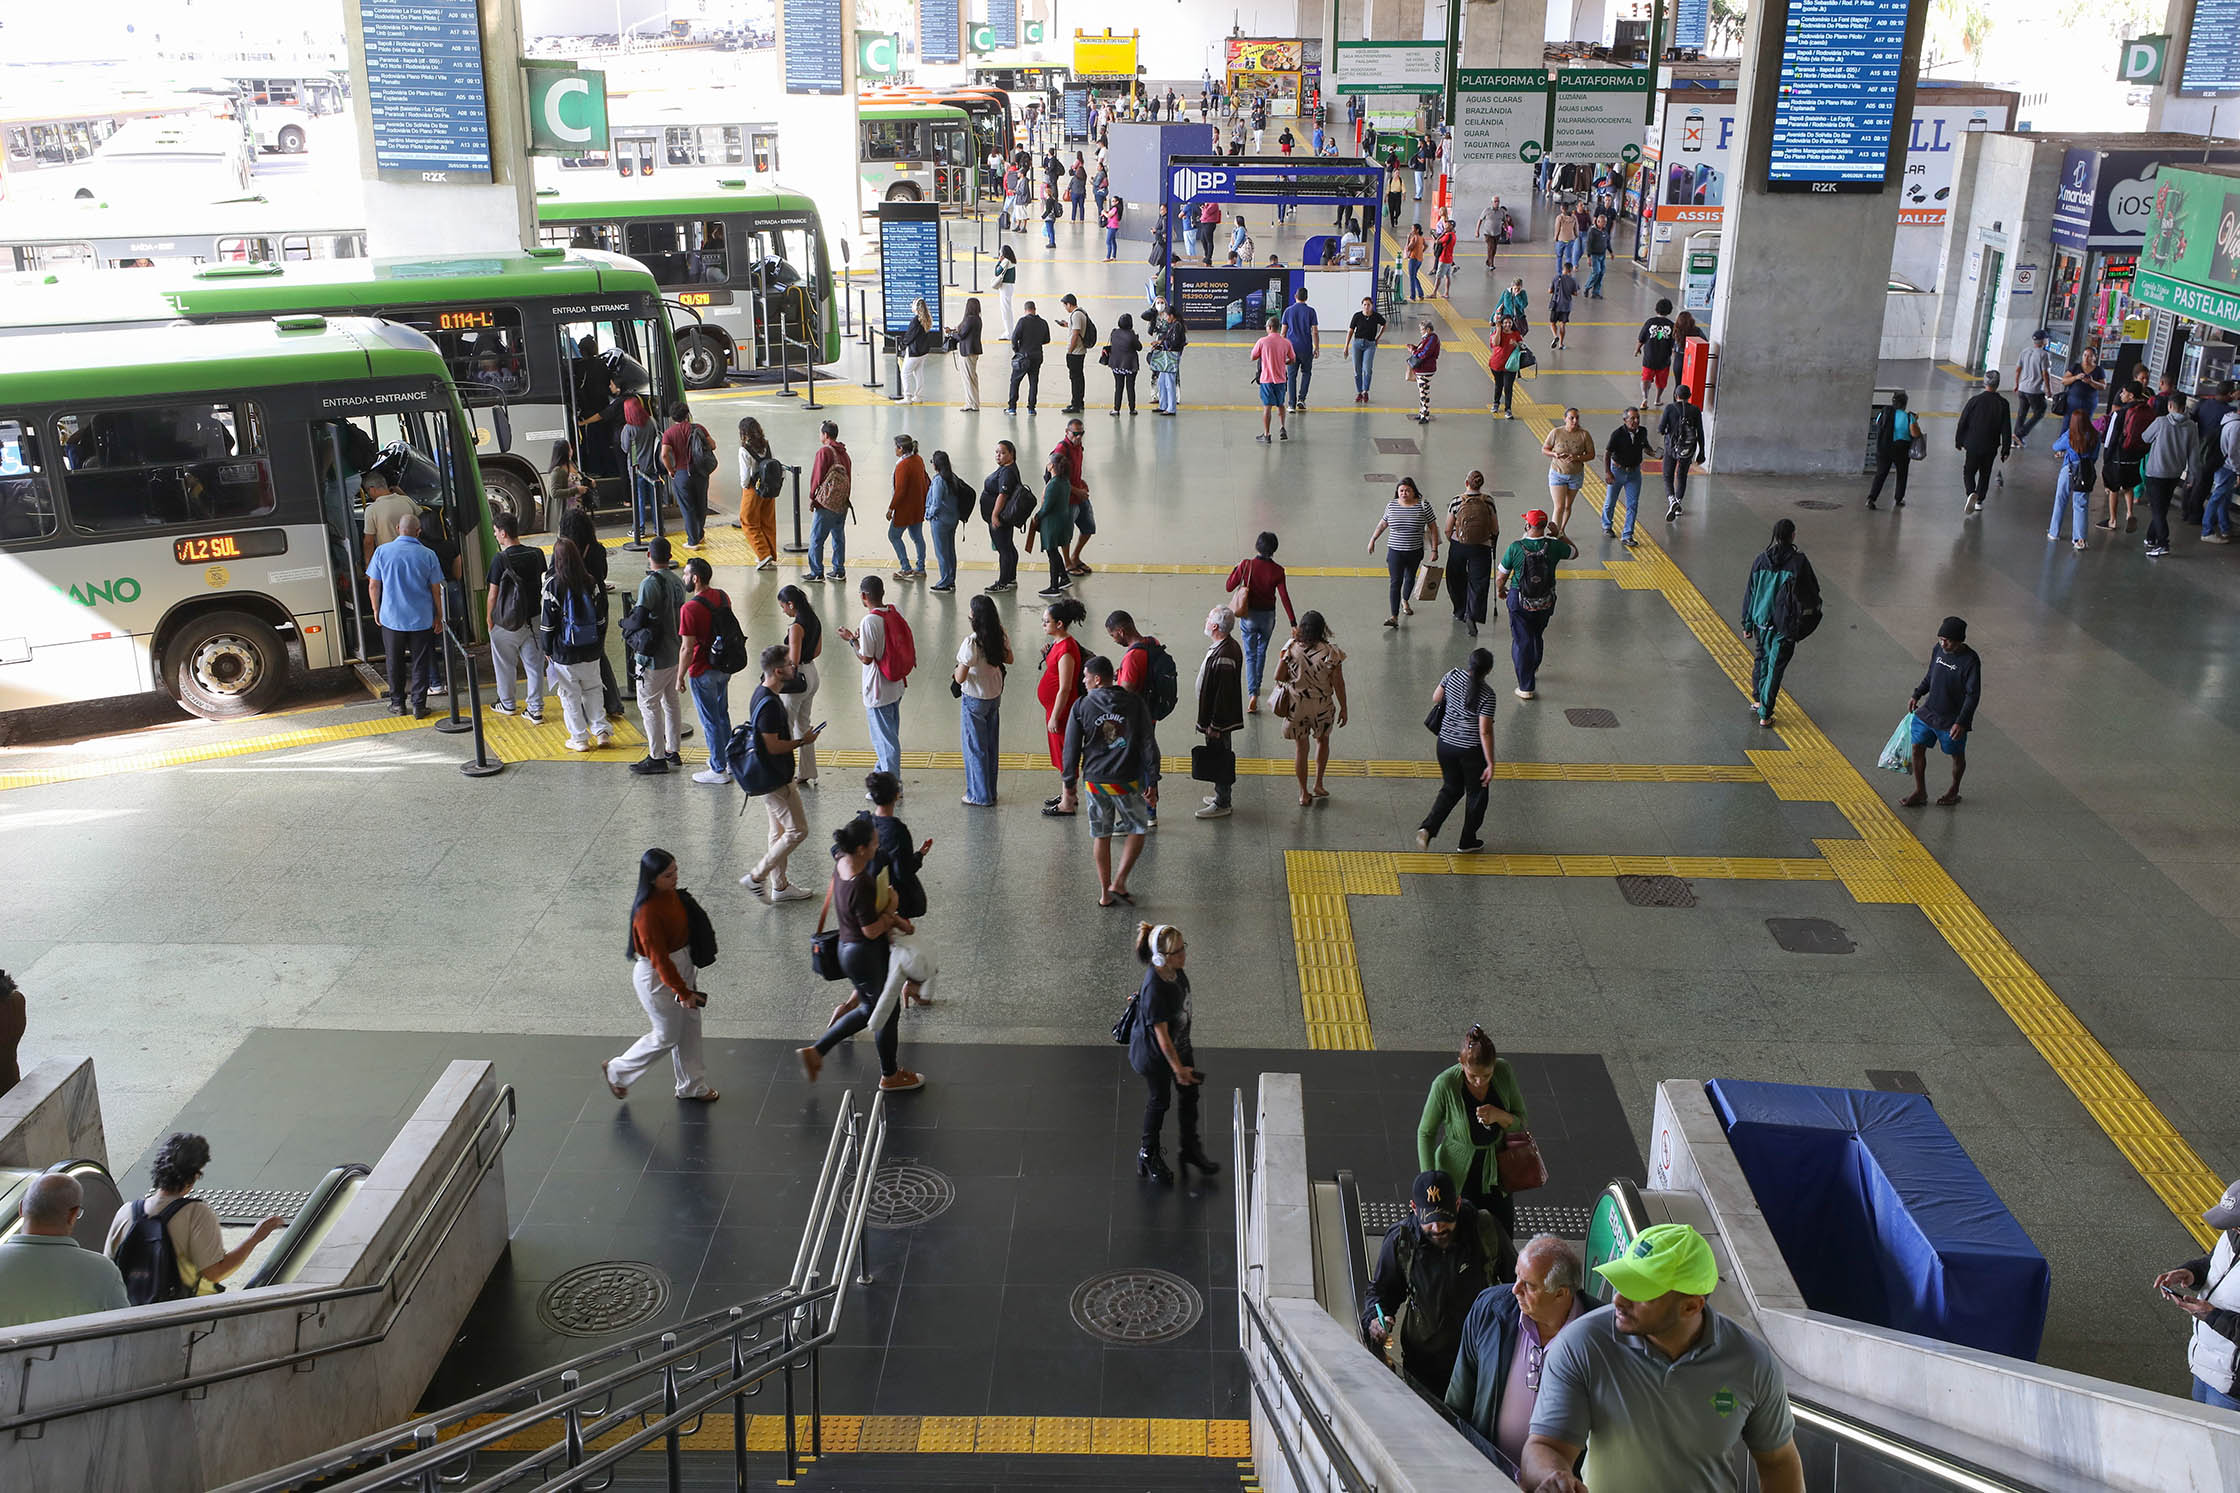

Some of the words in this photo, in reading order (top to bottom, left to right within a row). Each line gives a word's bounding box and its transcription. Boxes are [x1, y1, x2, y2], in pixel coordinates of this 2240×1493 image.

[974, 27, 992, 50] C
[1026, 24, 1040, 42] C
[866, 40, 892, 72] C
[2126, 44, 2157, 77] D
[1461, 76, 1534, 86] PLATAFORMA
[1535, 76, 1546, 86] C
[1561, 76, 1634, 86] PLATAFORMA
[1637, 76, 1645, 86] D
[545, 78, 591, 142] C
[422, 172, 447, 182] RZK
[1904, 165, 1926, 175] AR
[1198, 172, 1227, 189] BP
[1812, 182, 1838, 192] RZK
[2117, 196, 2153, 215] iOS
[553, 307, 586, 315] ENTRADA
[591, 304, 630, 312] ENTRANCE
[323, 397, 368, 407] ENTRADA
[375, 392, 427, 403] ENTRANCE
[211, 536, 240, 557] SUL
